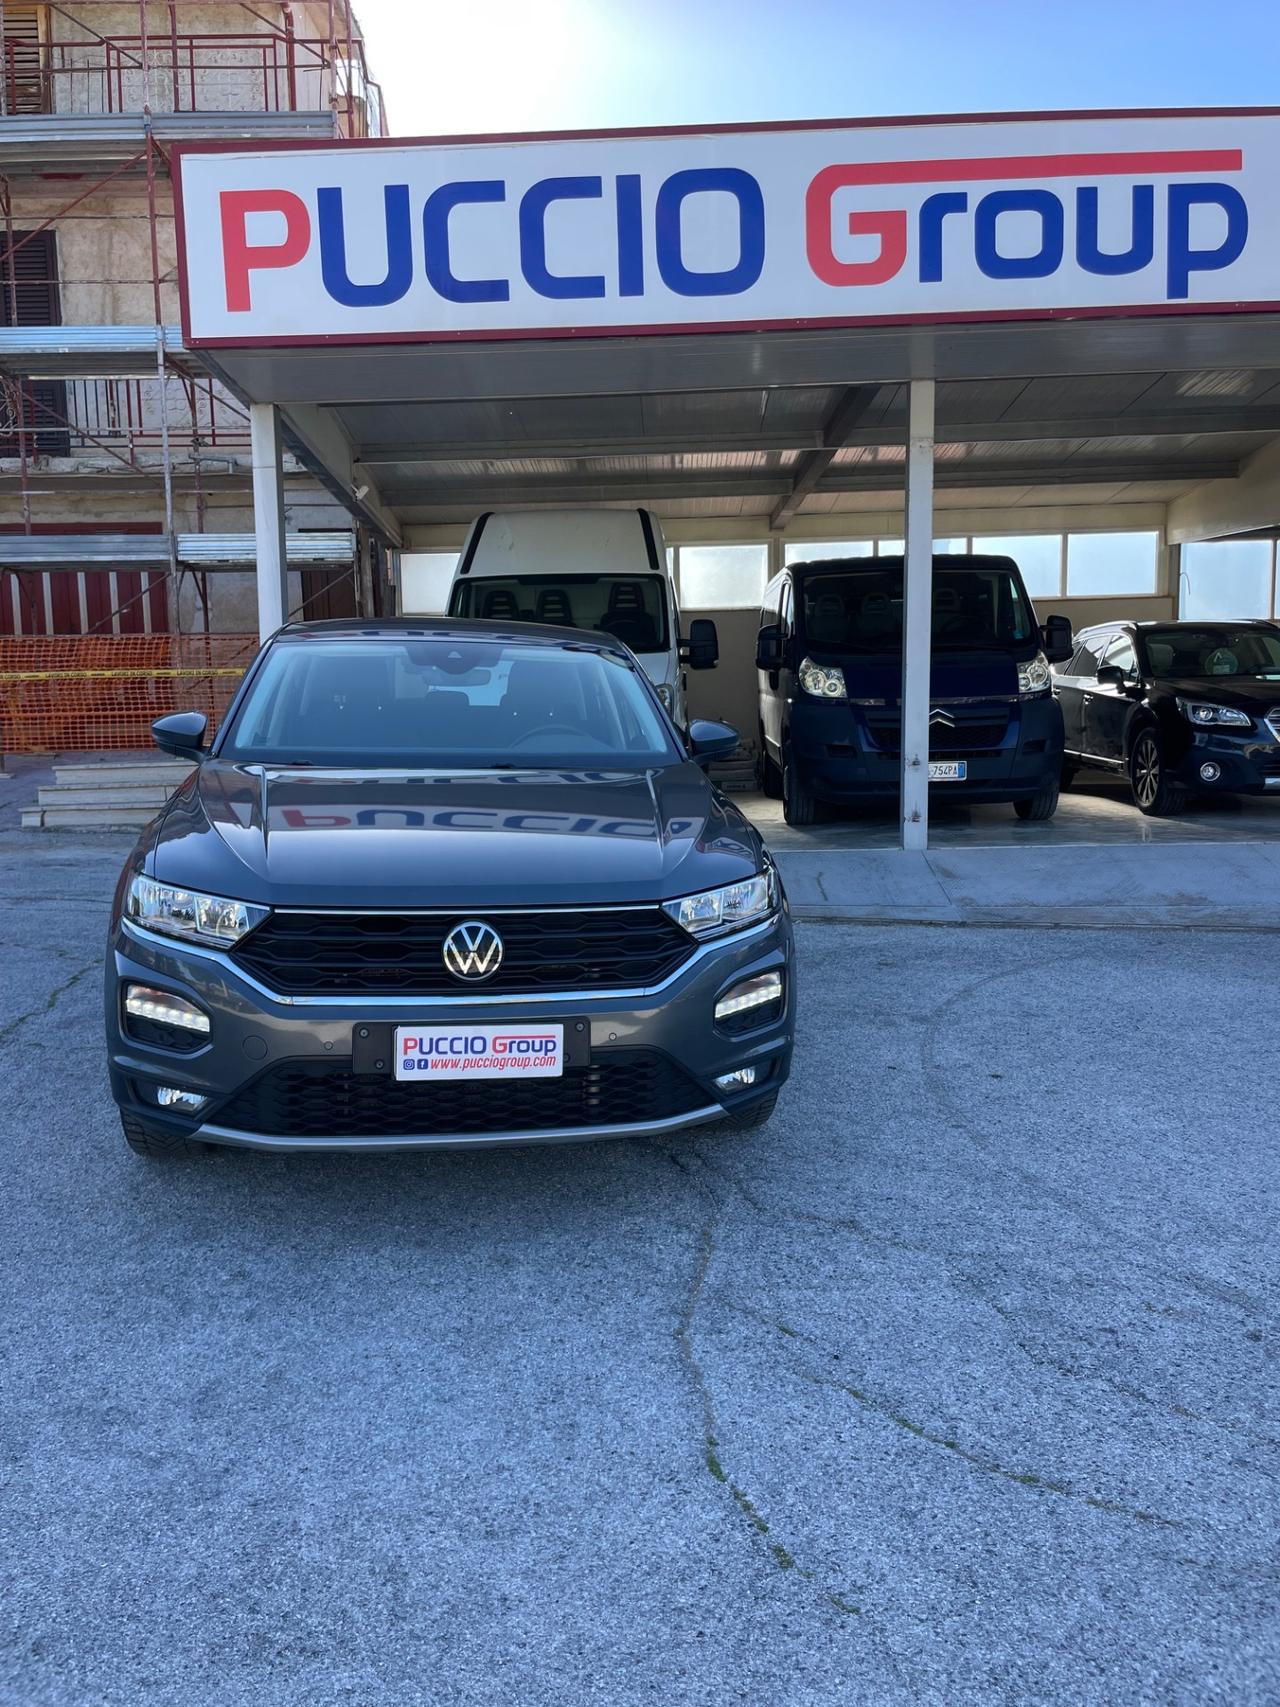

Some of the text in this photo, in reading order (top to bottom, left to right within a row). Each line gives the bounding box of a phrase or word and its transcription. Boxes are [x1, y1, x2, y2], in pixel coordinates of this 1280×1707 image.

[219, 148, 1249, 313] PUCCIO Group
[403, 1034, 557, 1056] PUCCIO Group
[430, 1055, 556, 1070] www.pucciogroup.com
